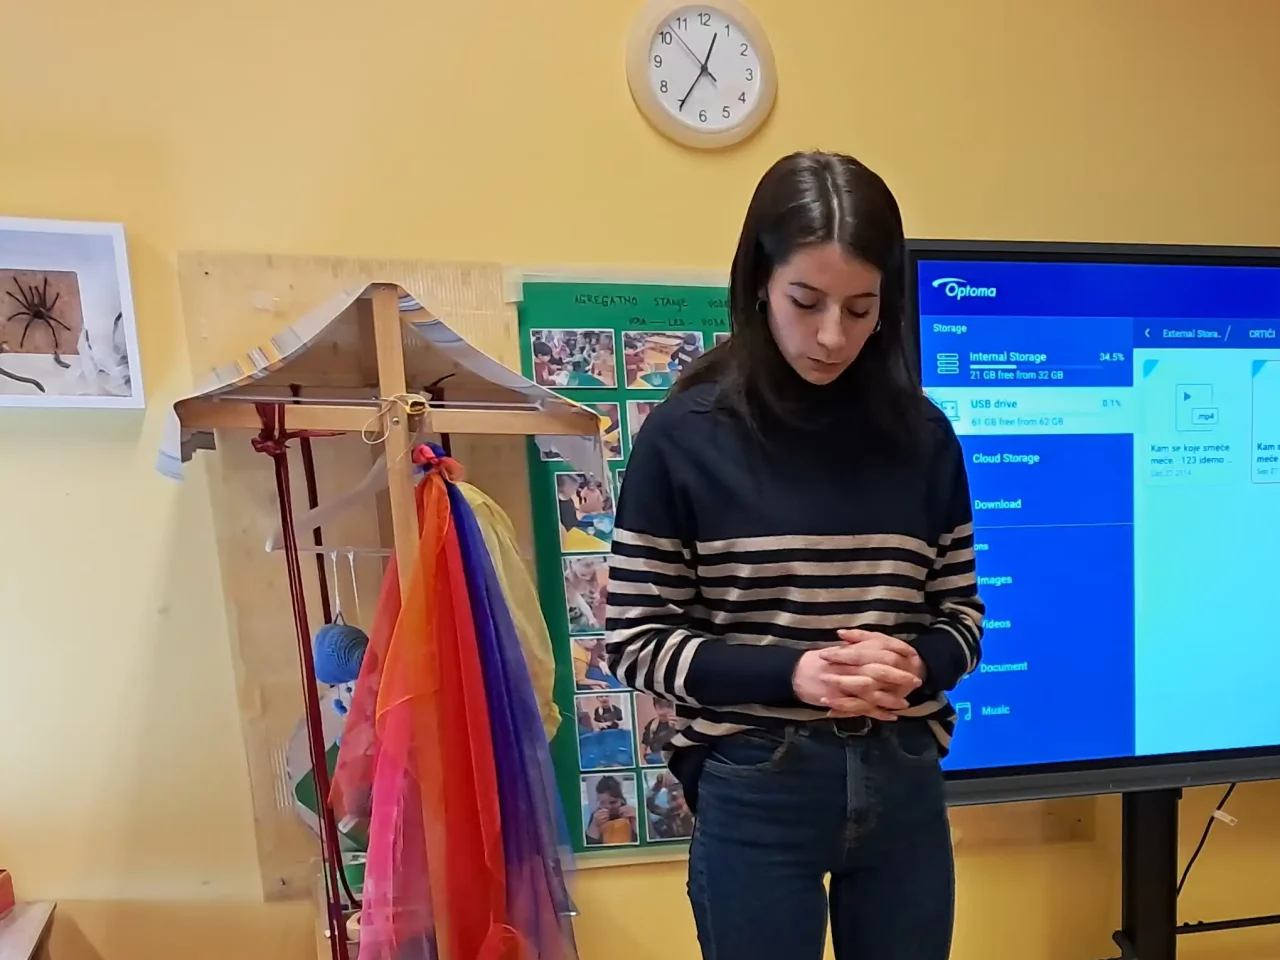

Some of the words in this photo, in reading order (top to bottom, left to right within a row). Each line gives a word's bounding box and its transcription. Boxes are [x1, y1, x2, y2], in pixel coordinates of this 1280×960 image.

[675, 17, 688, 31] 11
[697, 12, 711, 27] 12
[724, 24, 730, 37] 1
[658, 31, 673, 45] 10
[740, 43, 748, 56] 2
[653, 54, 663, 68] 9
[745, 68, 753, 81] 3
[659, 80, 668, 93] 8
[738, 91, 746, 104] 4
[698, 110, 707, 122] 6
[722, 106, 730, 119] 5
[945, 282, 997, 300] Optoma
[575, 294, 638, 307] AGREGATNO
[933, 323, 967, 334] Storage
[1163, 329, 1195, 338] External
[969, 351, 1007, 362] Internal
[1009, 352, 1047, 364] Storage
[1099, 352, 1125, 362] 34.5%
[970, 371, 980, 380] 21
[983, 370, 996, 380] GB
[998, 370, 1015, 380] free
[1016, 370, 1037, 380] from
[1038, 370, 1049, 380] 32
[1051, 370, 1064, 380] GB
[971, 399, 991, 409] USB
[994, 399, 1018, 409] drive
[984, 418, 997, 426] GB
[999, 417, 1015, 426] free
[1017, 417, 1037, 426] from
[1051, 417, 1064, 426] GB
[1150, 444, 1169, 452] Kam
[1183, 444, 1200, 454] koje
[1257, 442, 1275, 451] Kam
[973, 453, 1001, 463] Cloud
[1003, 453, 1040, 465] Storage
[1181, 456, 1197, 464] 123
[974, 499, 1022, 509] Download
[977, 575, 1012, 586] Images
[980, 661, 1028, 673] Document
[982, 705, 1011, 715] Music
